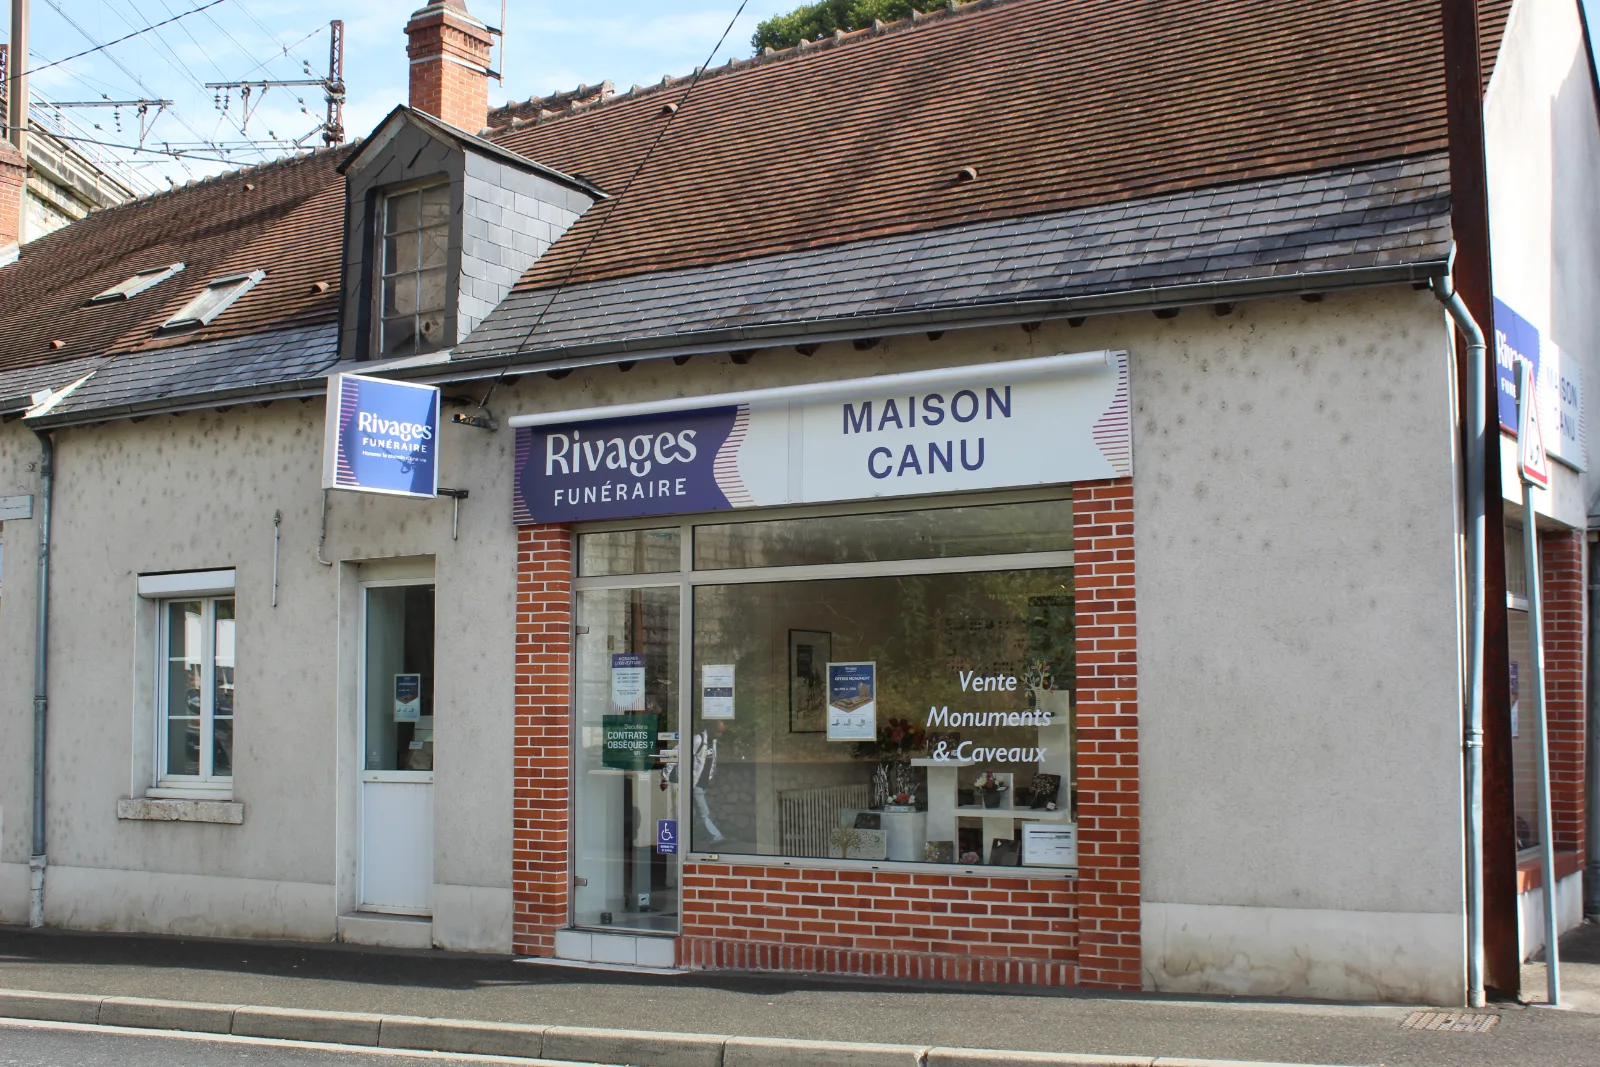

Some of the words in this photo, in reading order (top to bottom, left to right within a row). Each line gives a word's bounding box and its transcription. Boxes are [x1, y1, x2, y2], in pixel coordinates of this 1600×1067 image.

[843, 386, 1010, 434] MAISON
[358, 411, 432, 441] Rivages
[362, 438, 428, 452] FUNÉRAIRE
[545, 430, 697, 477] Rivages
[868, 438, 984, 479] CANU
[554, 477, 688, 507] FUNÉRAIRE
[959, 670, 1018, 692] Vente
[926, 705, 1052, 728] Monuments
[607, 731, 648, 739] CONTRATS
[932, 741, 950, 762] &
[956, 740, 1047, 763] Caveaux
